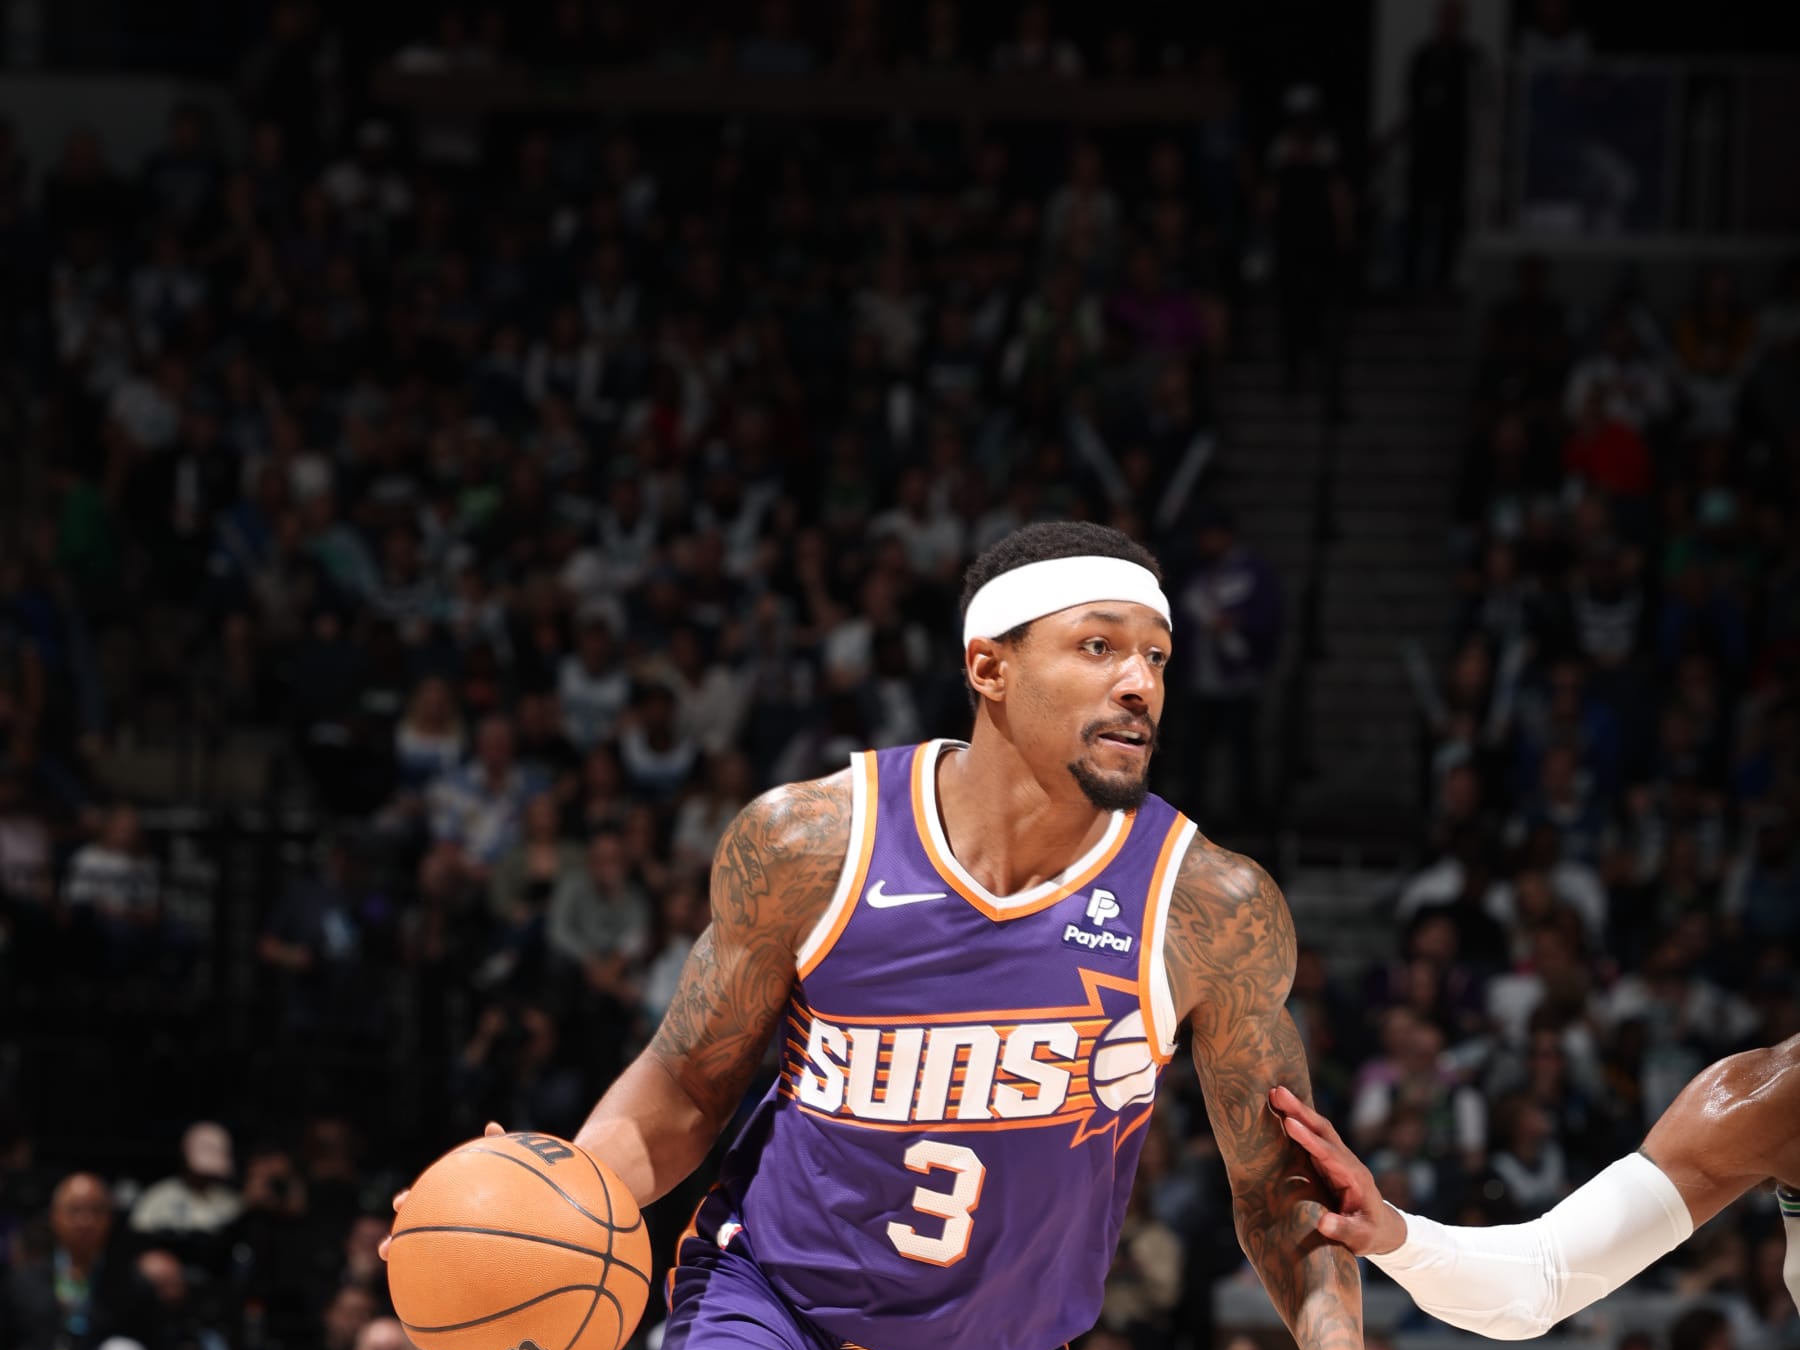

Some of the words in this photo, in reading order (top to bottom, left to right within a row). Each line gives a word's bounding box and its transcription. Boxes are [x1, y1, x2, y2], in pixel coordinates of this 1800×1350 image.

[1063, 923, 1133, 953] PayPal
[800, 1018, 1079, 1122] SUNS
[886, 1140, 987, 1268] 3
